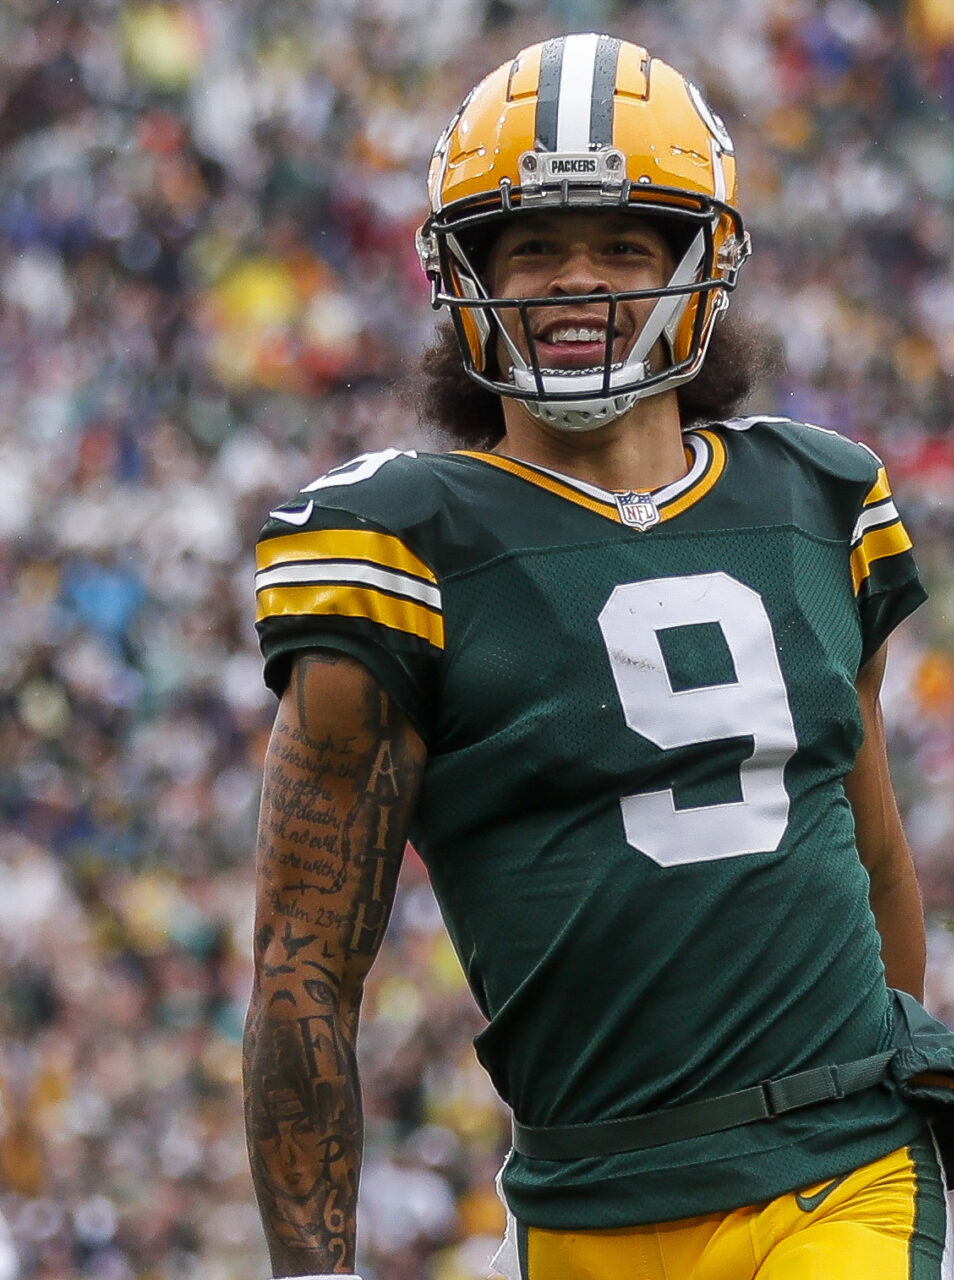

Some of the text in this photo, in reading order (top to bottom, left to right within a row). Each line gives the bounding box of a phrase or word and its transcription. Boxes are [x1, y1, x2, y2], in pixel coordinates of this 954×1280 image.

[551, 159, 597, 173] PACKERS
[625, 504, 653, 521] NFL
[597, 571, 798, 868] 9
